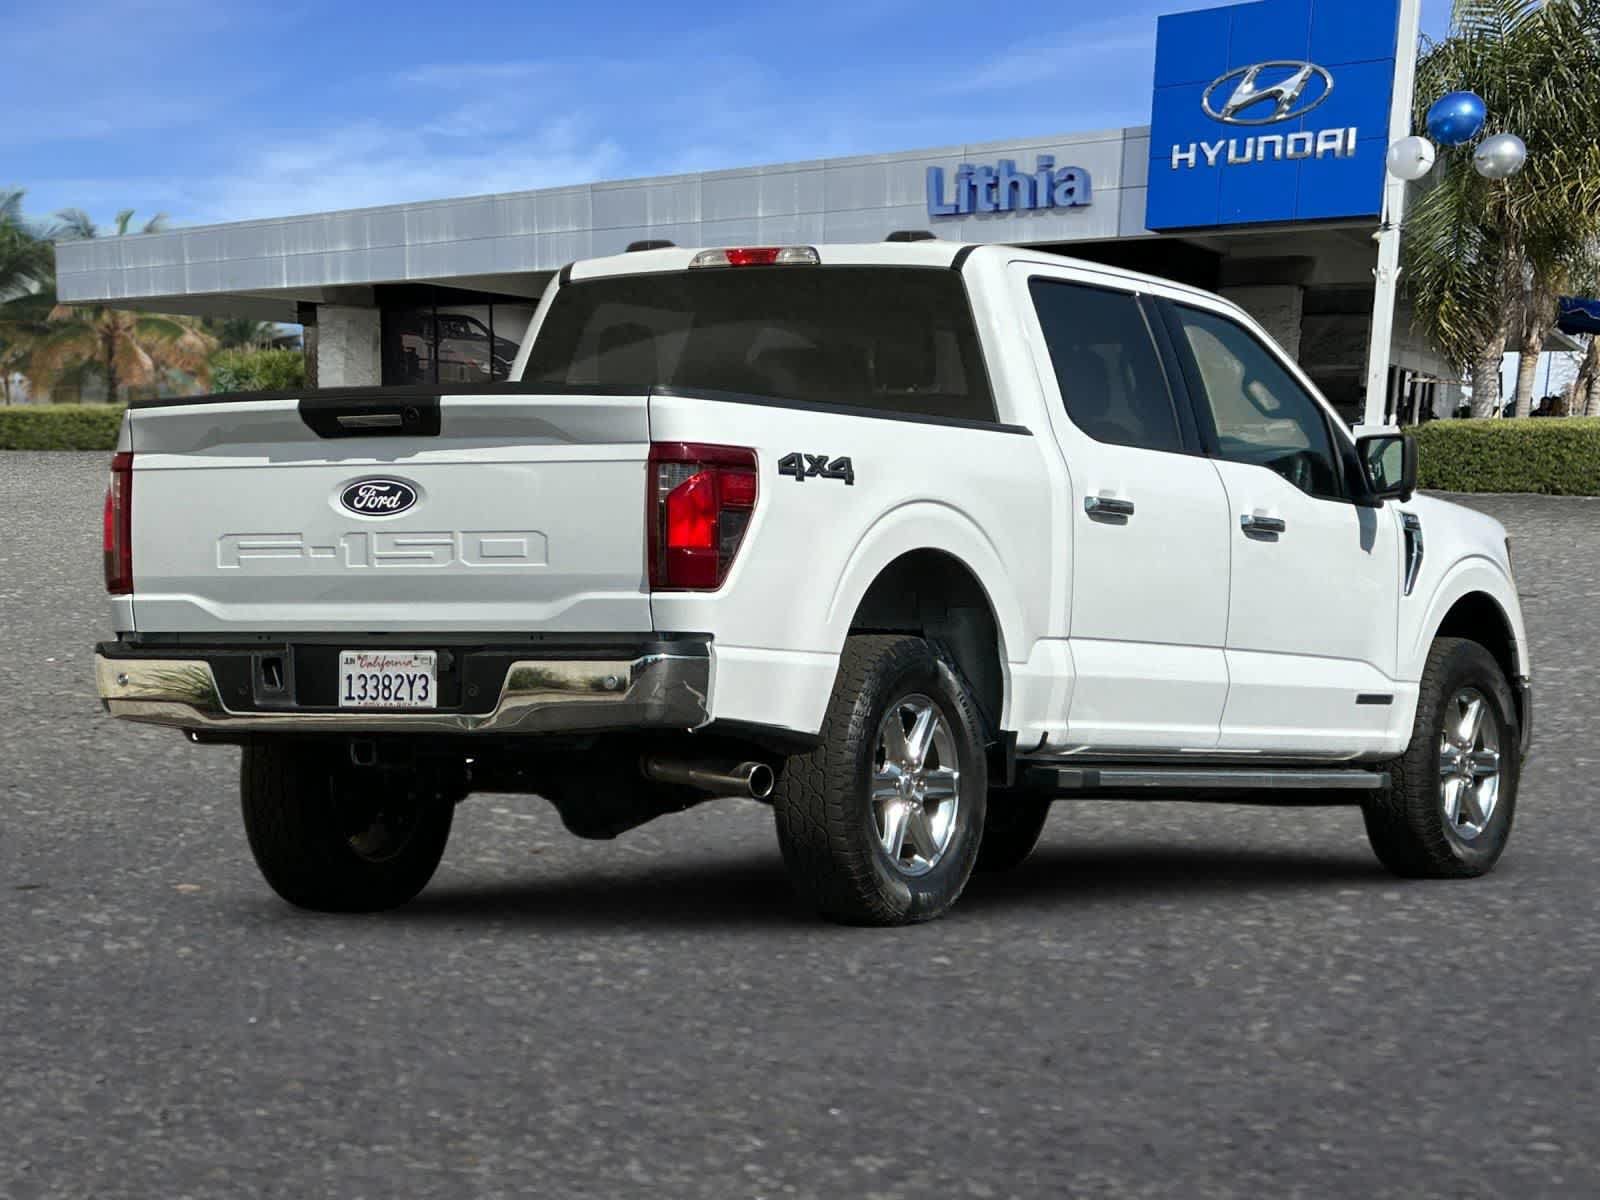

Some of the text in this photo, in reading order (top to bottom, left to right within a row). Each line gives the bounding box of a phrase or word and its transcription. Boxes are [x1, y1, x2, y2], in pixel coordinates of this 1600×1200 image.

[1171, 127, 1358, 170] HYUNDAI
[926, 154, 1092, 219] Lithia
[353, 485, 402, 510] Ford
[217, 530, 549, 569] F-150
[357, 655, 413, 672] California
[344, 673, 430, 701] 13382Y3
